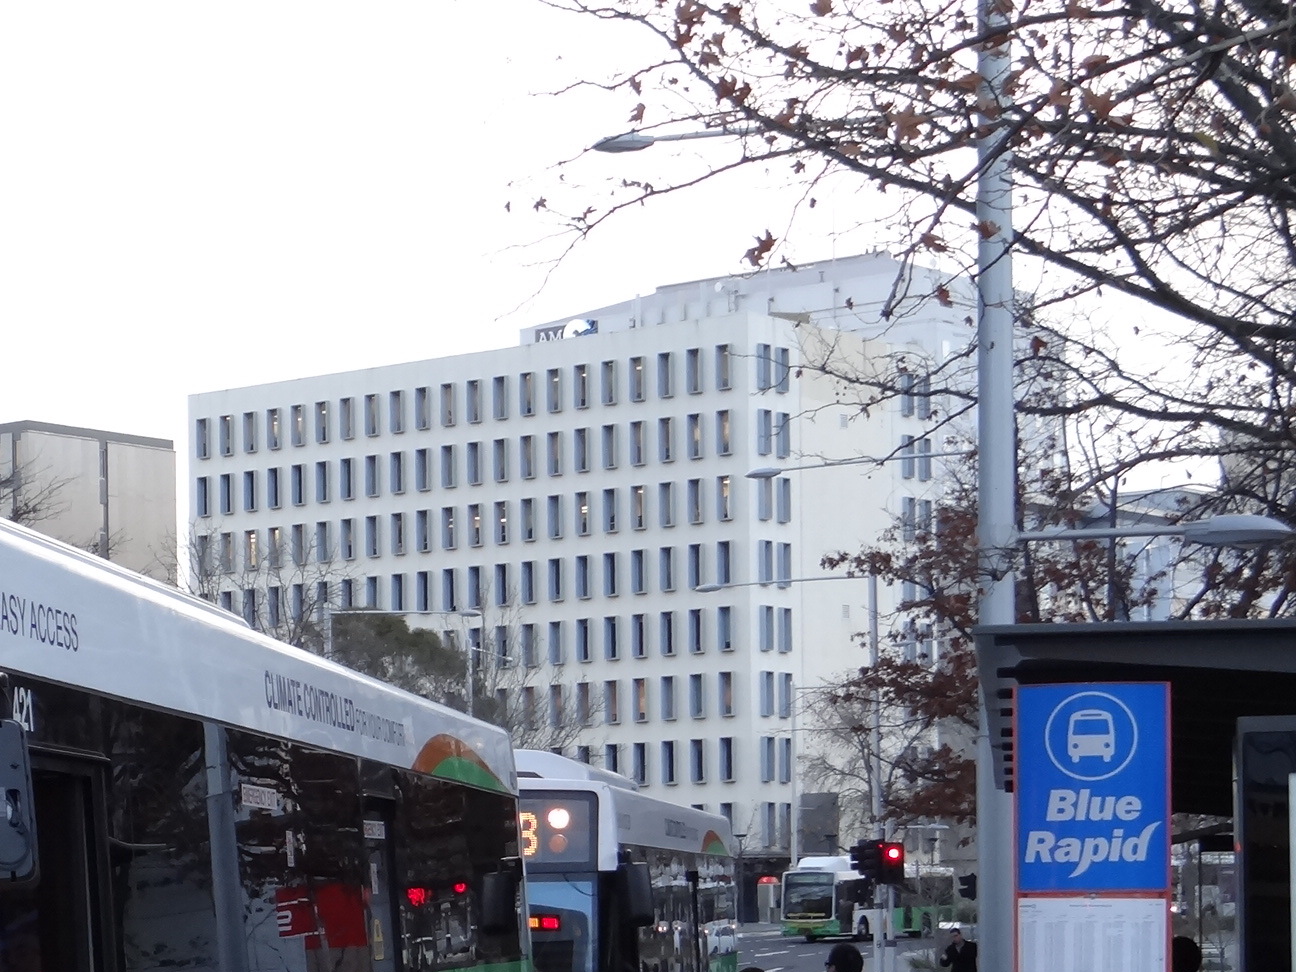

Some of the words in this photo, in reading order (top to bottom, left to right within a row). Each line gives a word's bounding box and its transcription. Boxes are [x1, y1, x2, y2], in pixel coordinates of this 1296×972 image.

[29, 601, 79, 652] ACCESS
[12, 686, 34, 732] 421
[264, 670, 303, 716] CLIMATE
[303, 683, 355, 732] CONTROLLED
[1046, 789, 1142, 822] Blue
[1025, 820, 1162, 878] Rapid
